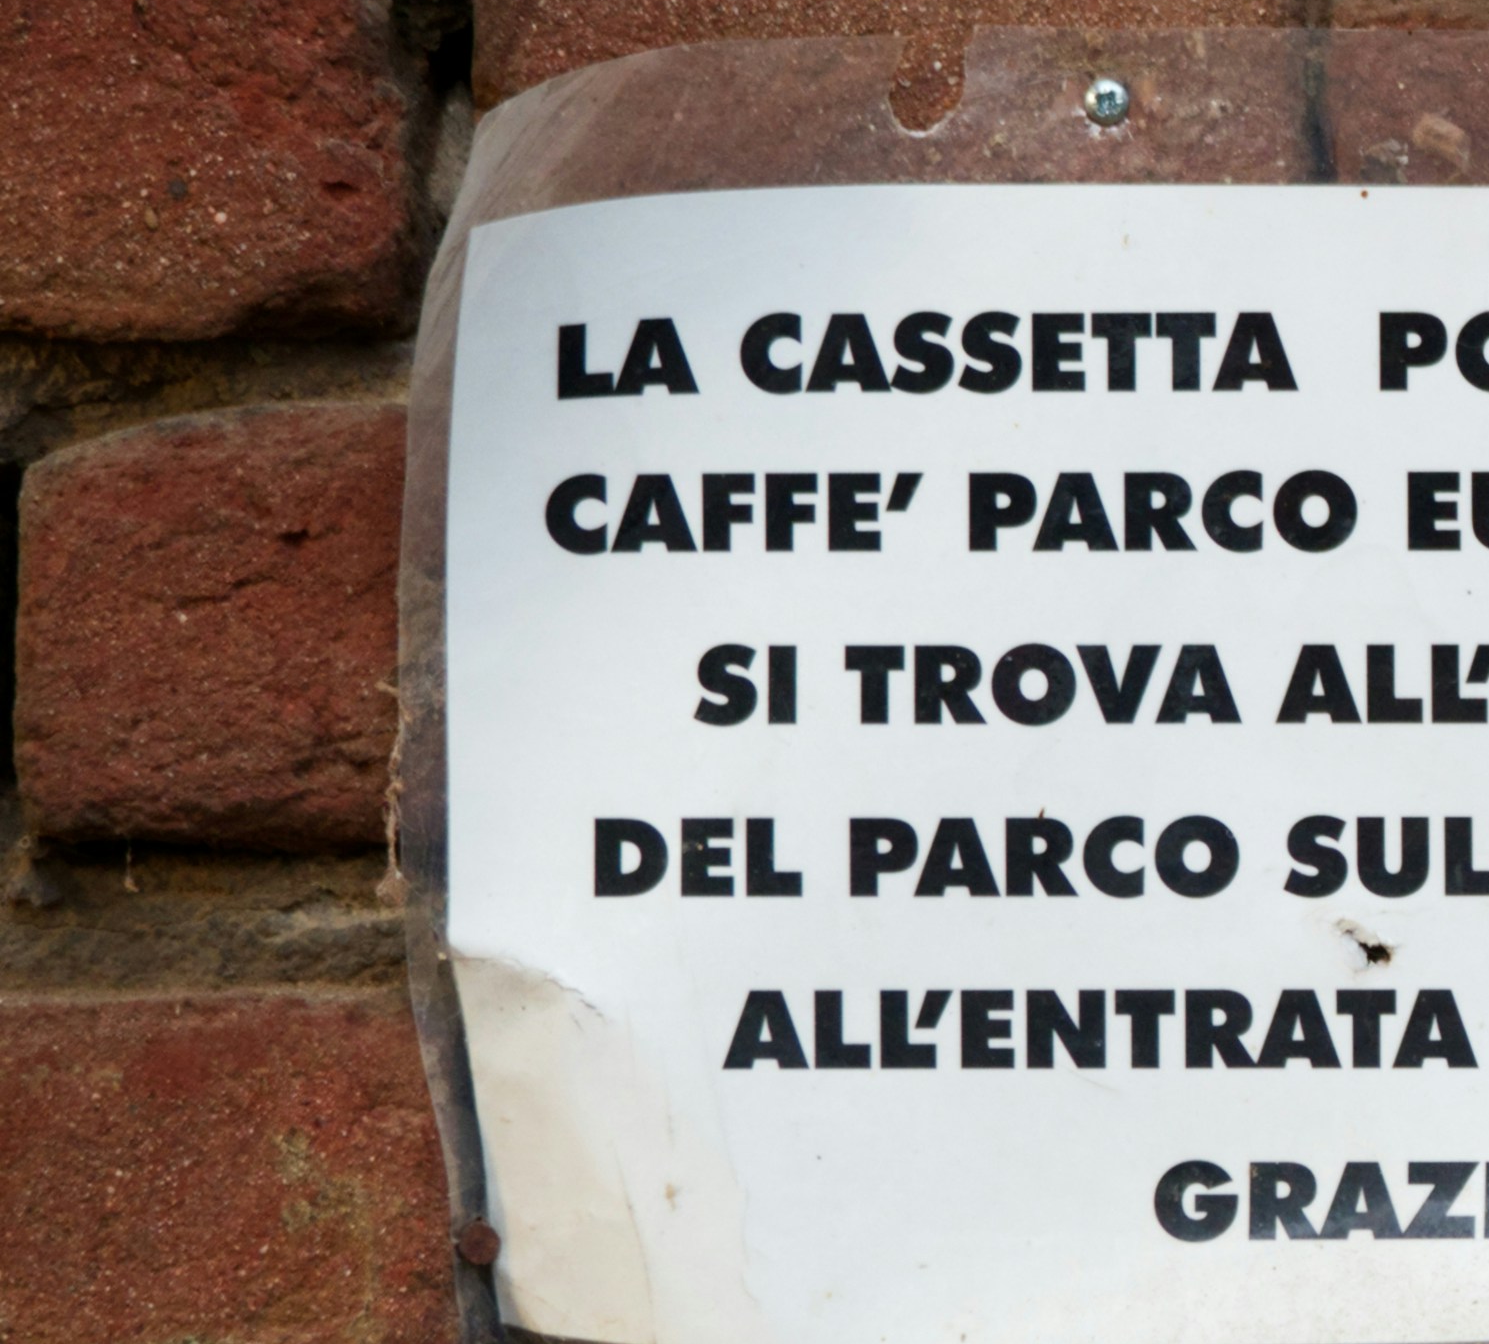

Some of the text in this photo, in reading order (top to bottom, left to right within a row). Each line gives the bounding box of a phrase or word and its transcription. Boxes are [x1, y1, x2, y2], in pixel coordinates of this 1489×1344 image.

[556, 316, 699, 400] LA
[739, 310, 1298, 395] CASSETTA
[544, 471, 922, 555] CAFFE'
[968, 469, 1358, 553] PARCO
[693, 643, 797, 727] SI
[844, 642, 1242, 727] TROVA
[593, 817, 803, 898] DEL
[848, 813, 1240, 899] PARCO
[722, 988, 1478, 1070] ALL'ENTRATA
